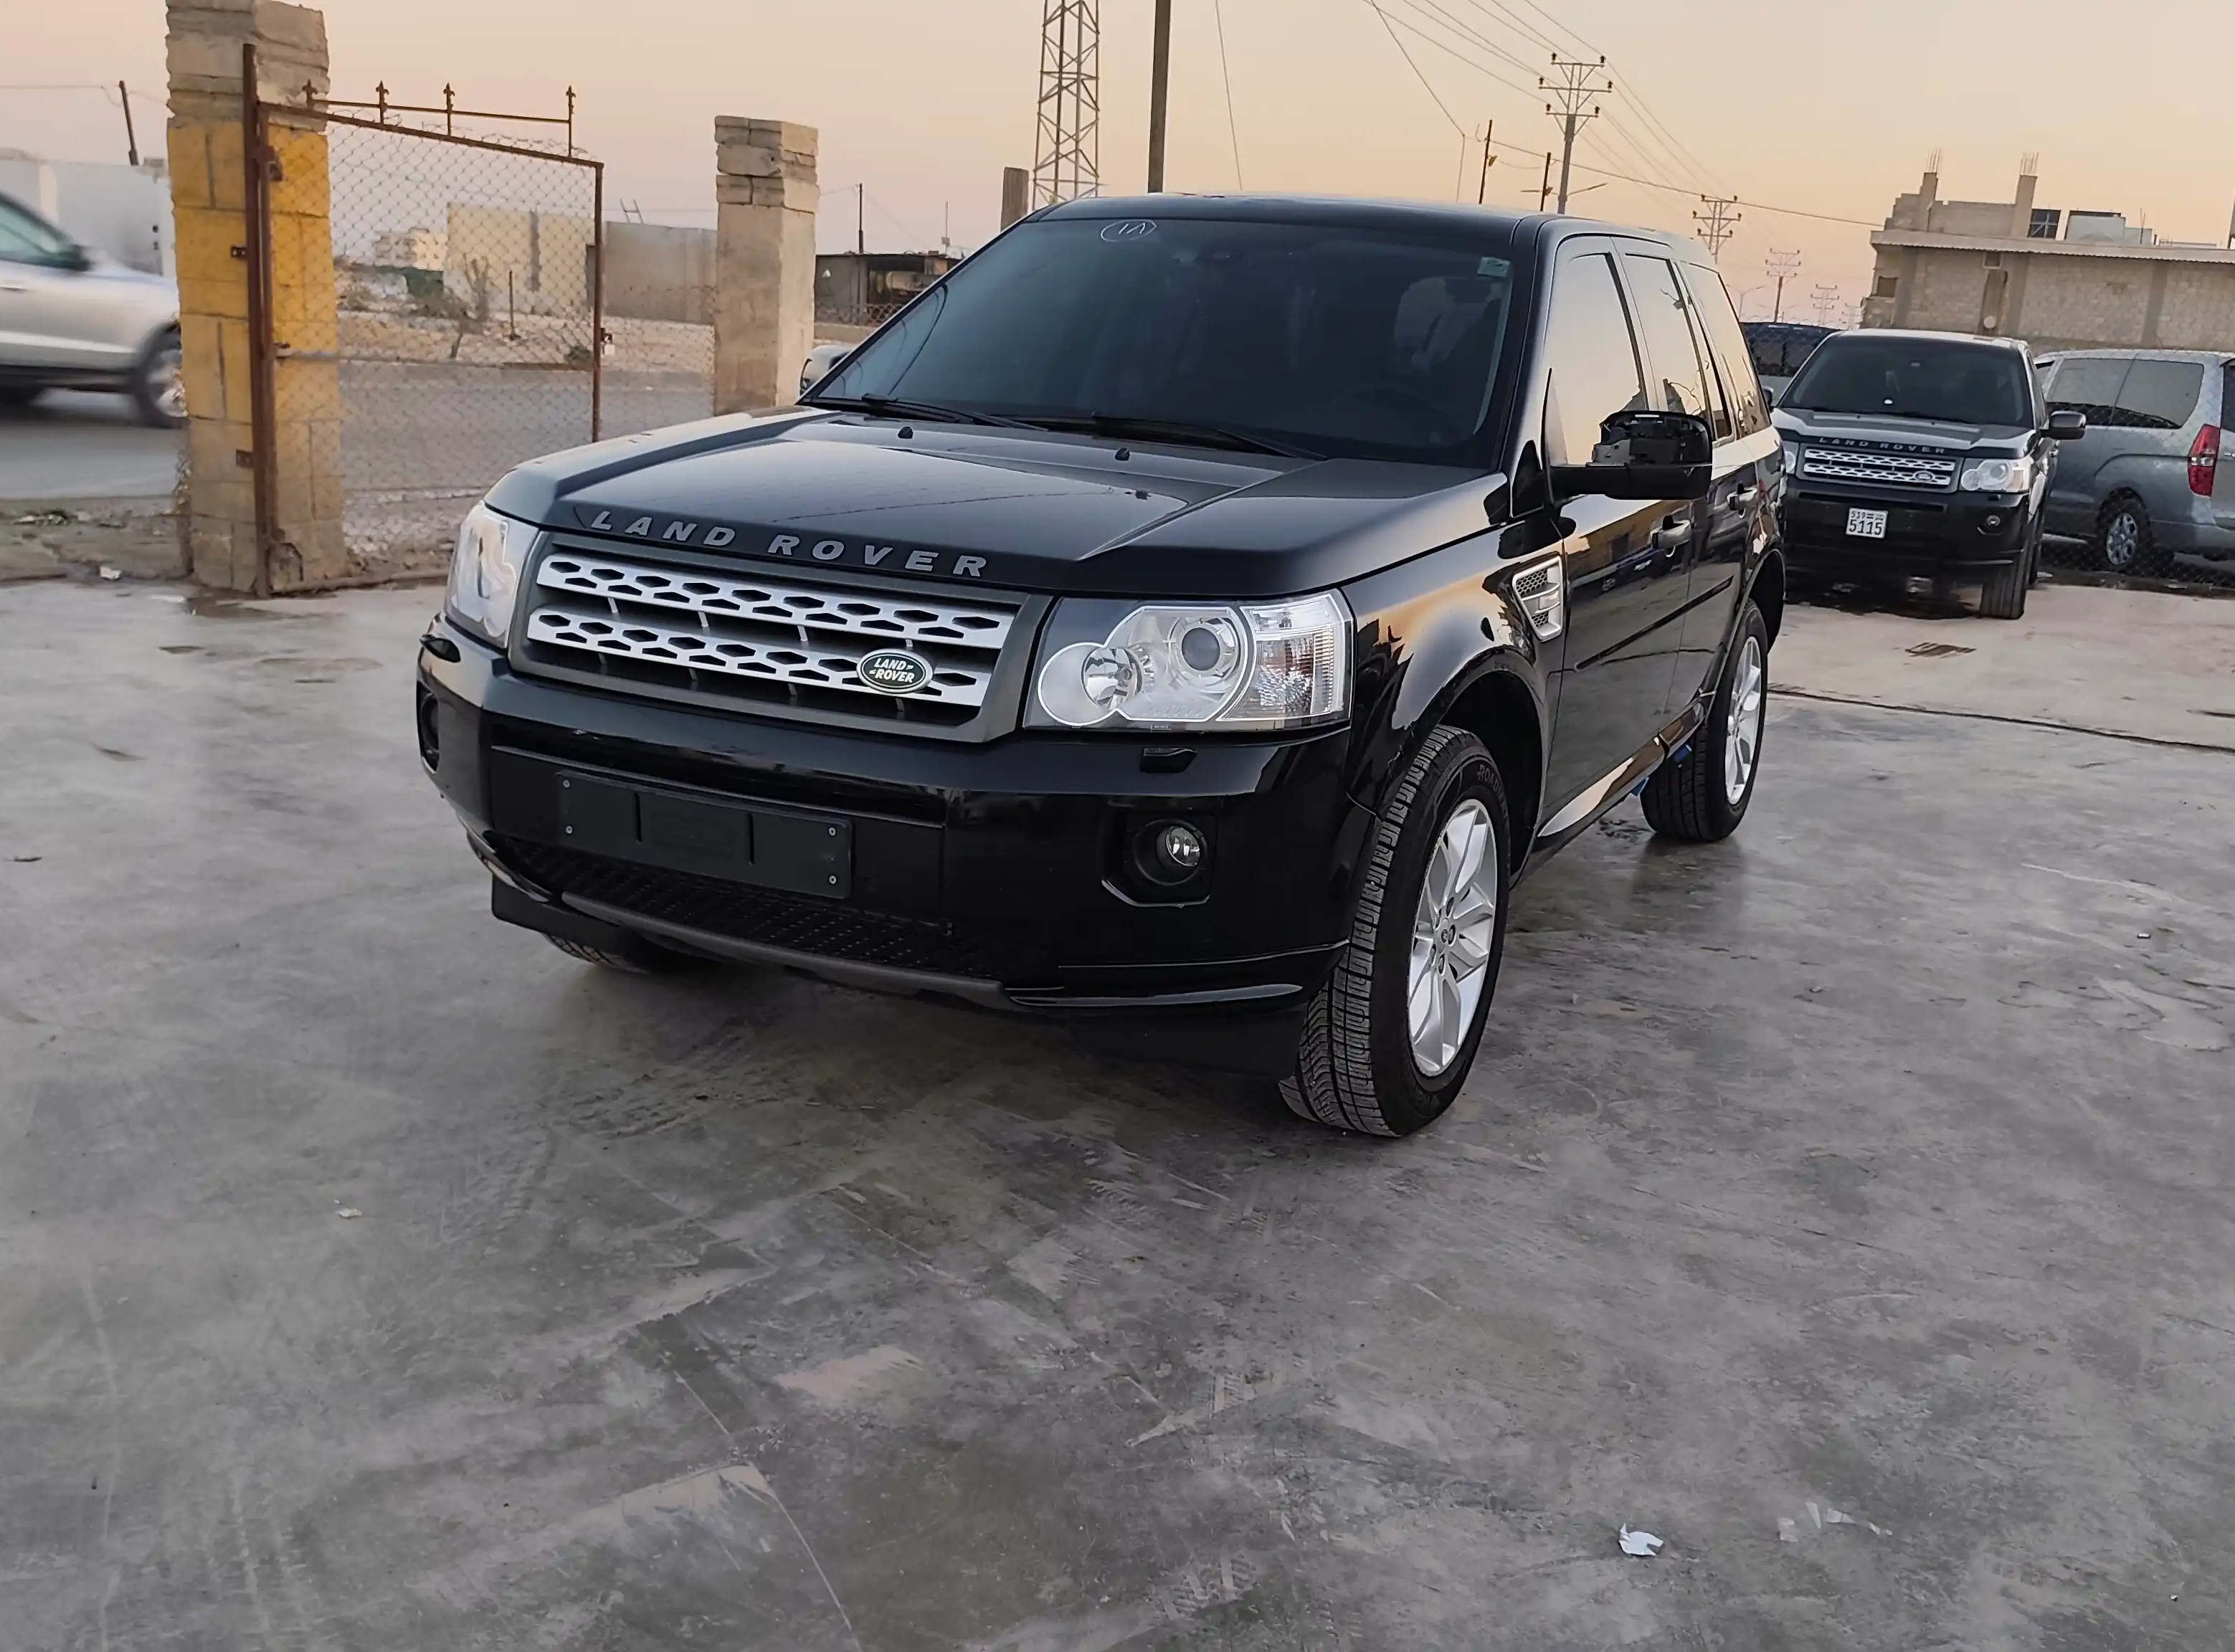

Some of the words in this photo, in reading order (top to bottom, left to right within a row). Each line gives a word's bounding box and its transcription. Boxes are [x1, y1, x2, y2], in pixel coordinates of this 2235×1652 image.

[1819, 437, 1869, 447] LAND
[1879, 443, 1945, 454] ROVER
[1849, 519, 1883, 536] 5115
[591, 510, 736, 546] LAND
[767, 534, 987, 577] ROVER
[873, 658, 907, 670] LAND
[874, 668, 915, 683] ROVER
